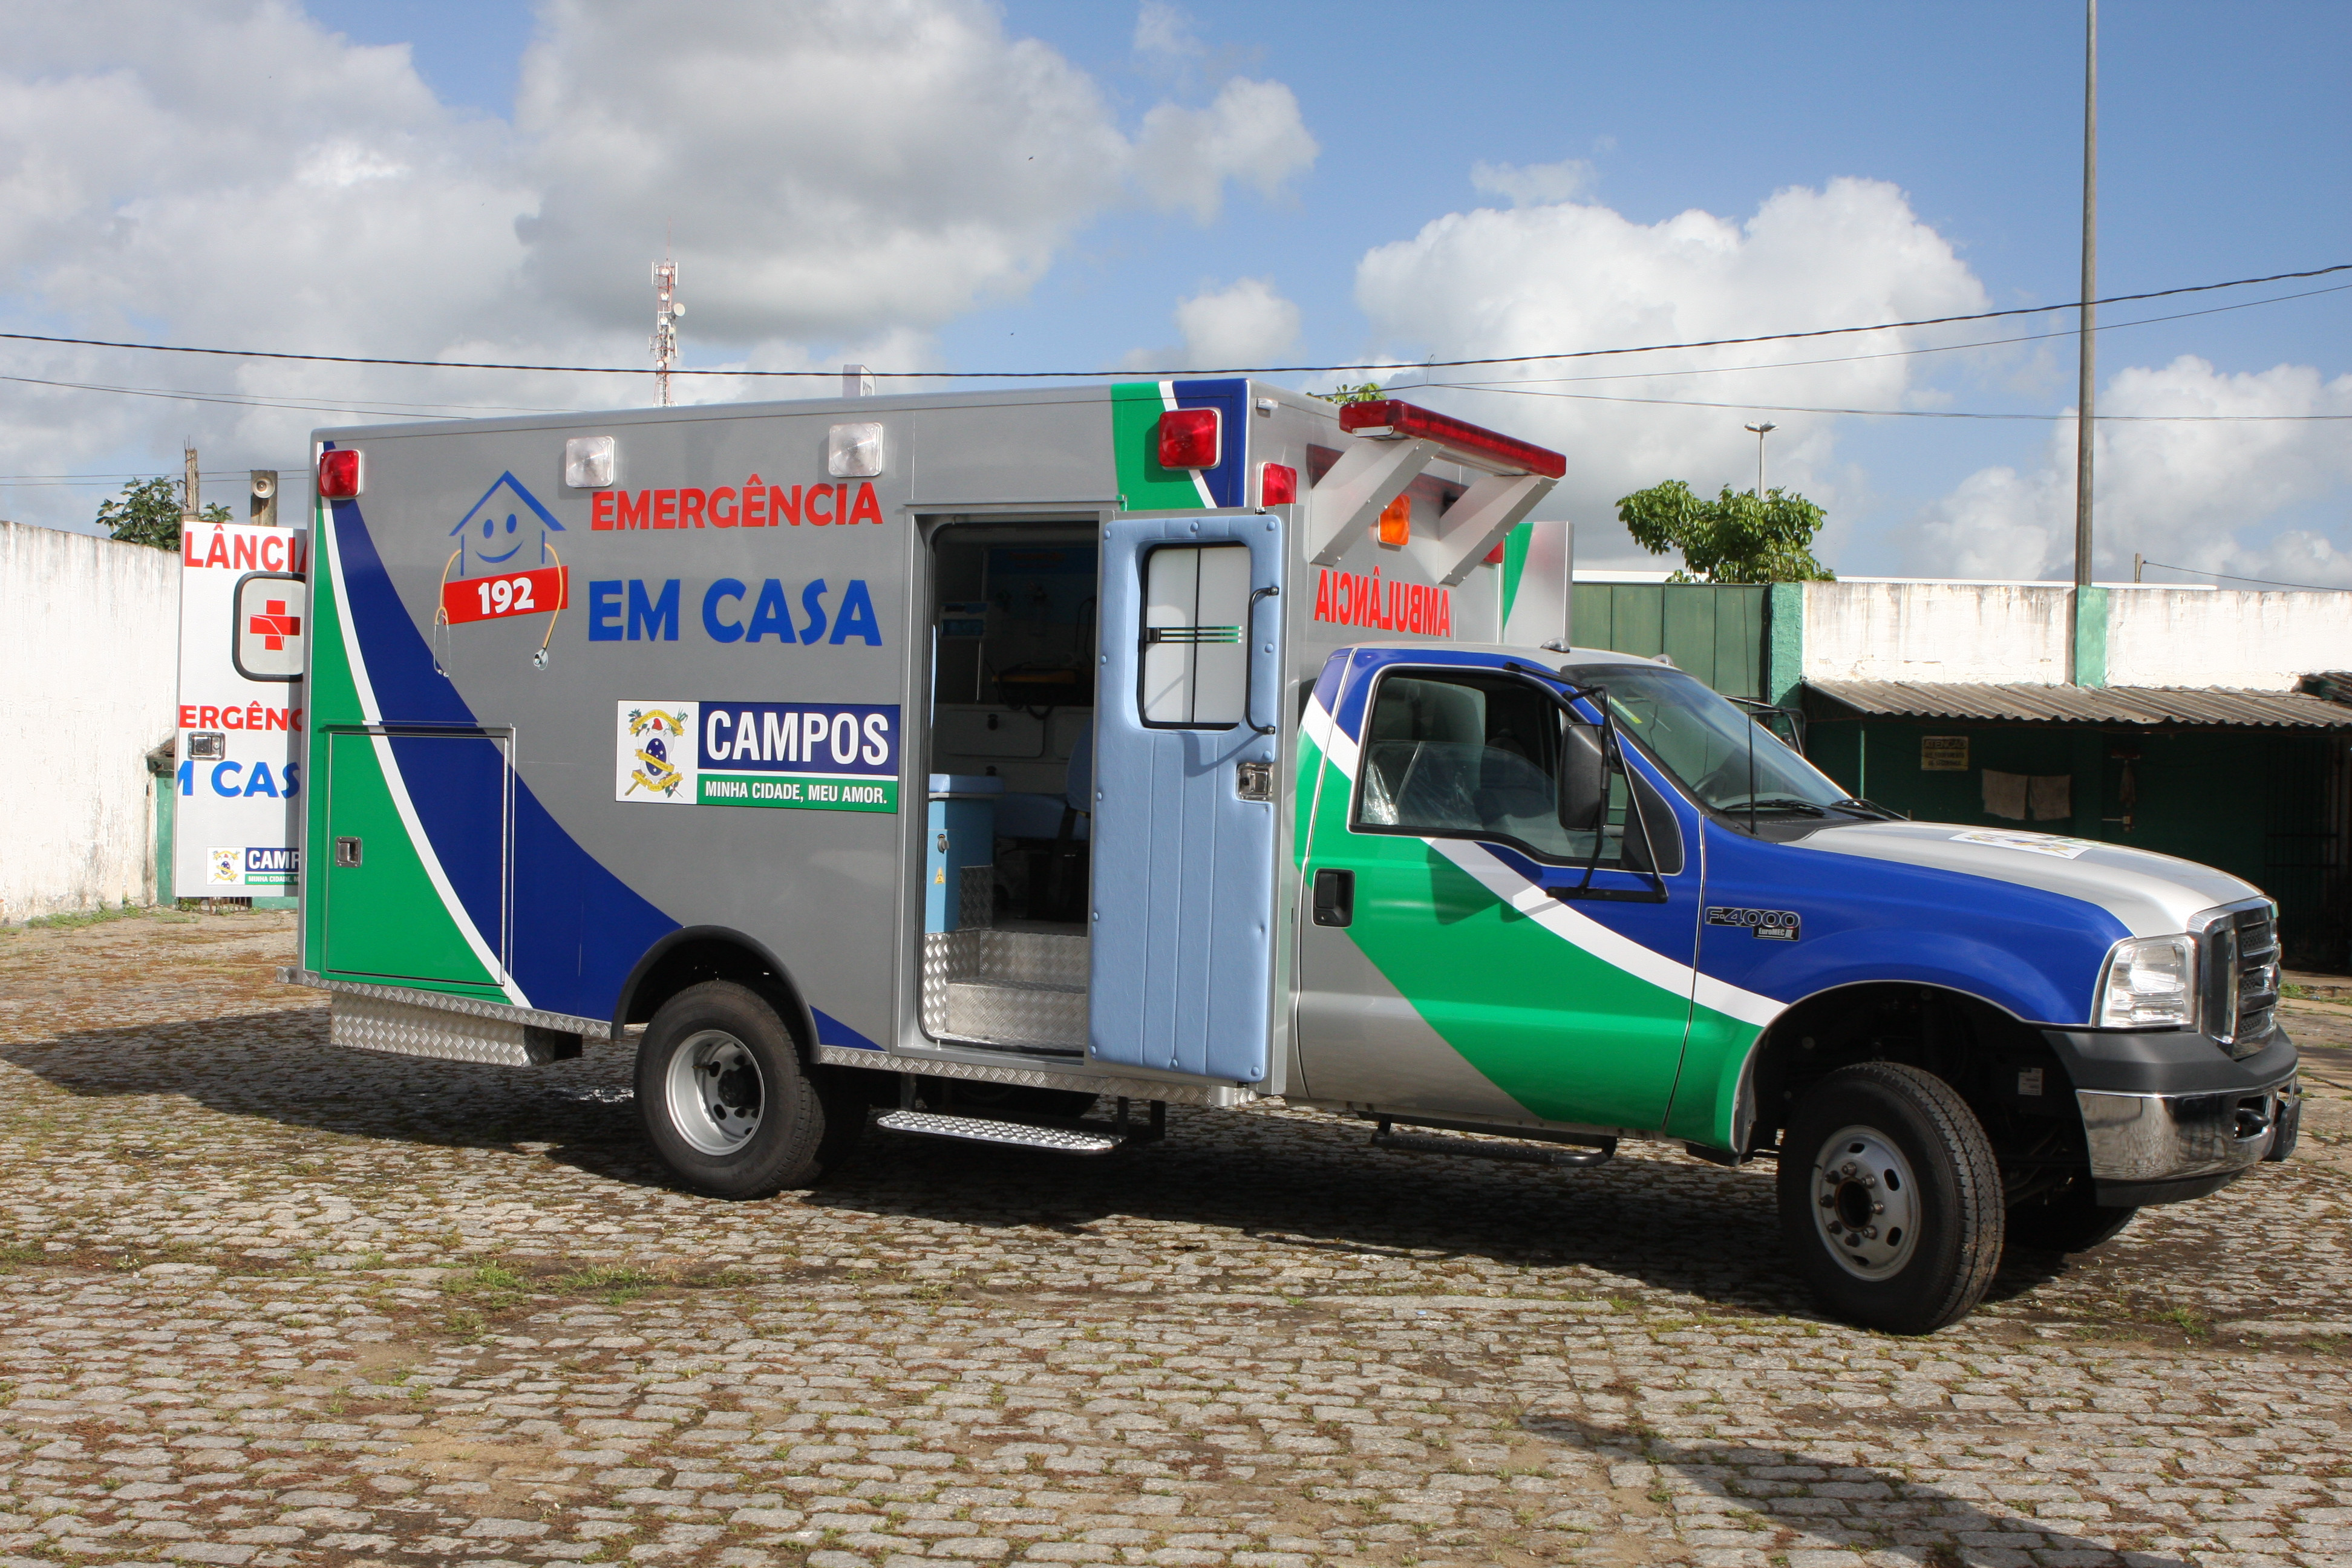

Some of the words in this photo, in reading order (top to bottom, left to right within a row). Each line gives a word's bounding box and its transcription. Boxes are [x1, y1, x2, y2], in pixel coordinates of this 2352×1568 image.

[590, 474, 883, 531] EMERGÊNCIA
[478, 577, 534, 615] 192
[588, 578, 681, 642] EM
[702, 578, 883, 646] CASA
[707, 710, 889, 766] CAMPOS
[705, 781, 748, 799] MINHA
[752, 782, 803, 803] CIDADE,
[808, 785, 838, 802] MEU
[841, 786, 887, 804] AMOR.
